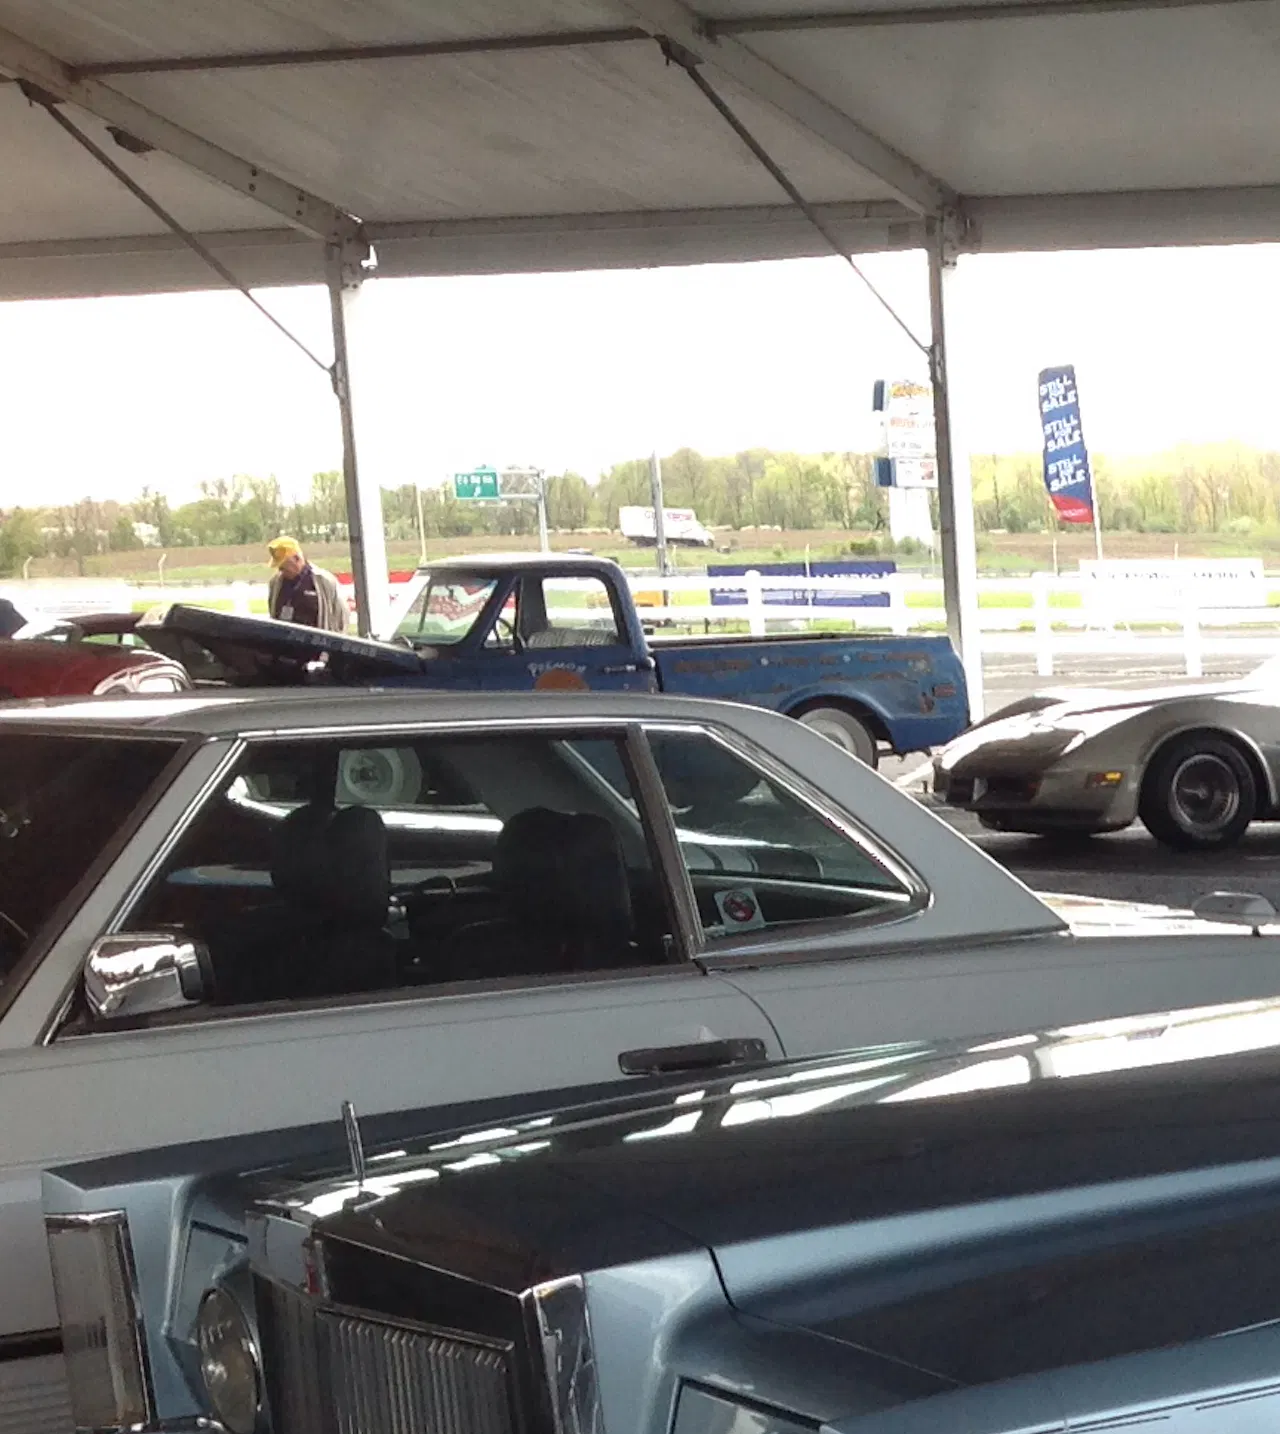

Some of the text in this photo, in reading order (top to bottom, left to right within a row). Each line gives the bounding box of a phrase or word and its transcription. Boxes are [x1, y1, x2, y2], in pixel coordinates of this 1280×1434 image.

[1040, 374, 1072, 396] STILL
[1043, 390, 1076, 412] SALE
[1044, 414, 1078, 435] STILL
[1047, 430, 1081, 452] SALE
[1048, 454, 1082, 475] STILL
[1050, 469, 1085, 492] SALE
